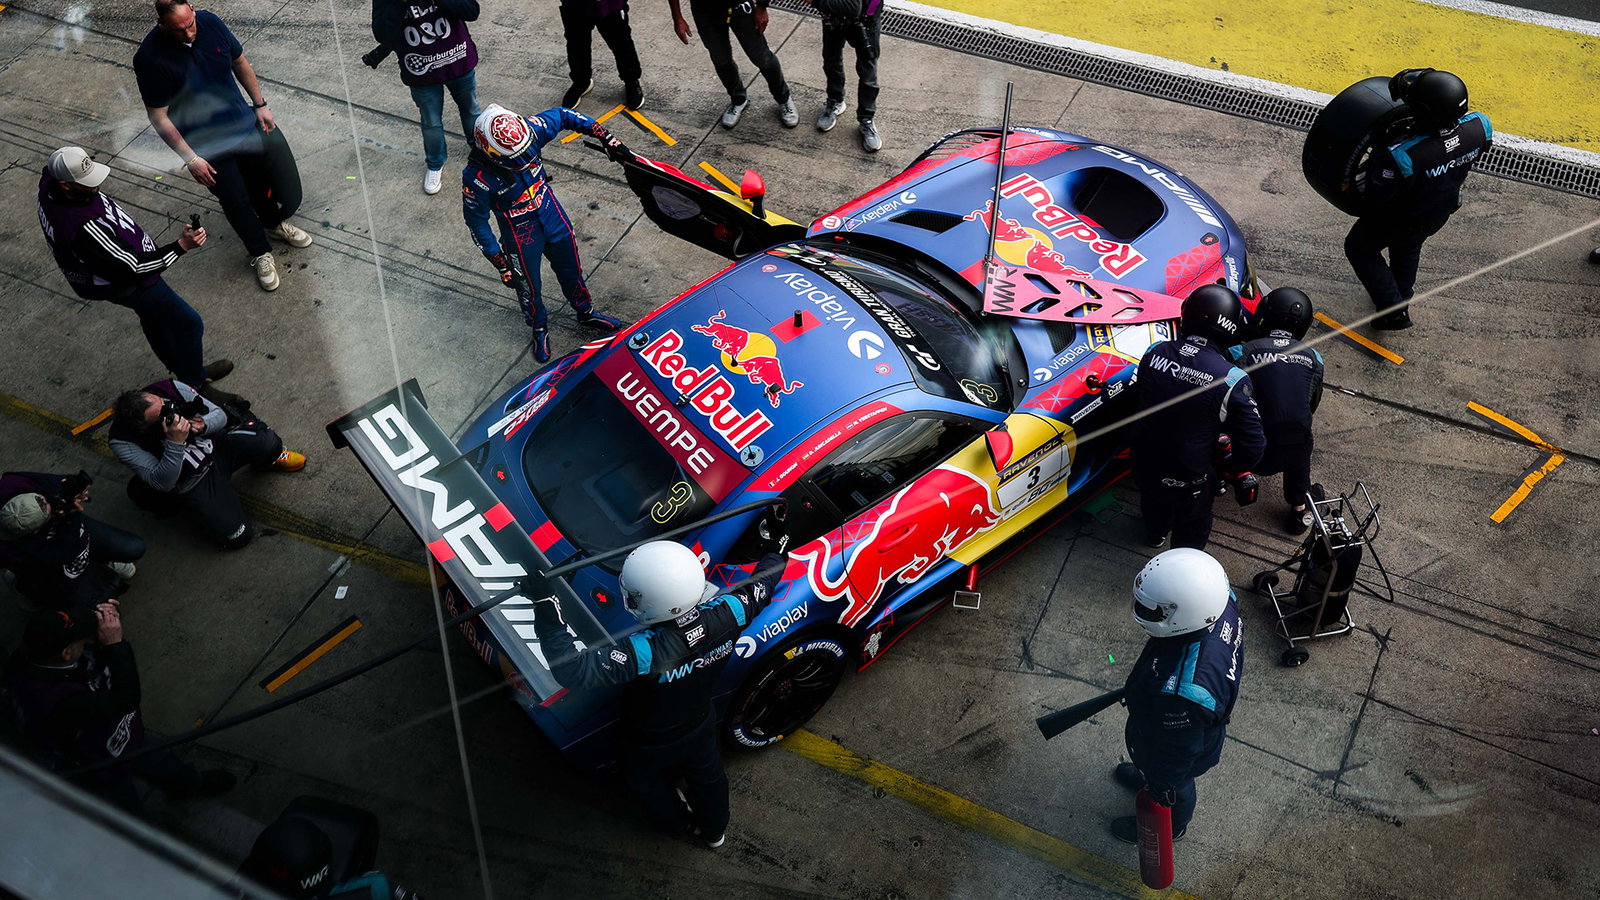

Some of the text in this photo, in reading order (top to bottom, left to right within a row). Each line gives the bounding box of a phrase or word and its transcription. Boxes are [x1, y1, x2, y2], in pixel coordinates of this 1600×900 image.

[423, 41, 467, 63] nürburgring
[1445, 137, 1460, 149] OMP
[1091, 145, 1186, 193] AMG
[861, 199, 903, 224] viaplay
[823, 268, 881, 308] TURISMO
[991, 267, 1018, 313] WNR
[774, 273, 856, 331] viaplay
[871, 307, 912, 339] GRAN
[1217, 314, 1237, 334] WNR
[1049, 342, 1090, 370] viaplay
[1181, 345, 1199, 355] OMP
[1251, 352, 1288, 364] WNR
[1149, 354, 1181, 378] WNR
[1181, 366, 1213, 382] WINWARD
[640, 329, 774, 453] Red Bull
[961, 378, 998, 403] 3
[1179, 374, 1211, 389] RACING
[616, 371, 715, 475] WEMPE
[1003, 440, 1060, 480] RAVENOL
[1027, 465, 1041, 489] 3
[357, 403, 529, 578] AMG
[651, 481, 692, 524] 3
[756, 601, 809, 643] viaplay
[687, 627, 704, 642] OMP
[610, 651, 628, 662] OMP
[704, 646, 733, 667] RACING
[805, 641, 845, 658] MICHELIN
[733, 728, 767, 747] MICHELIN
